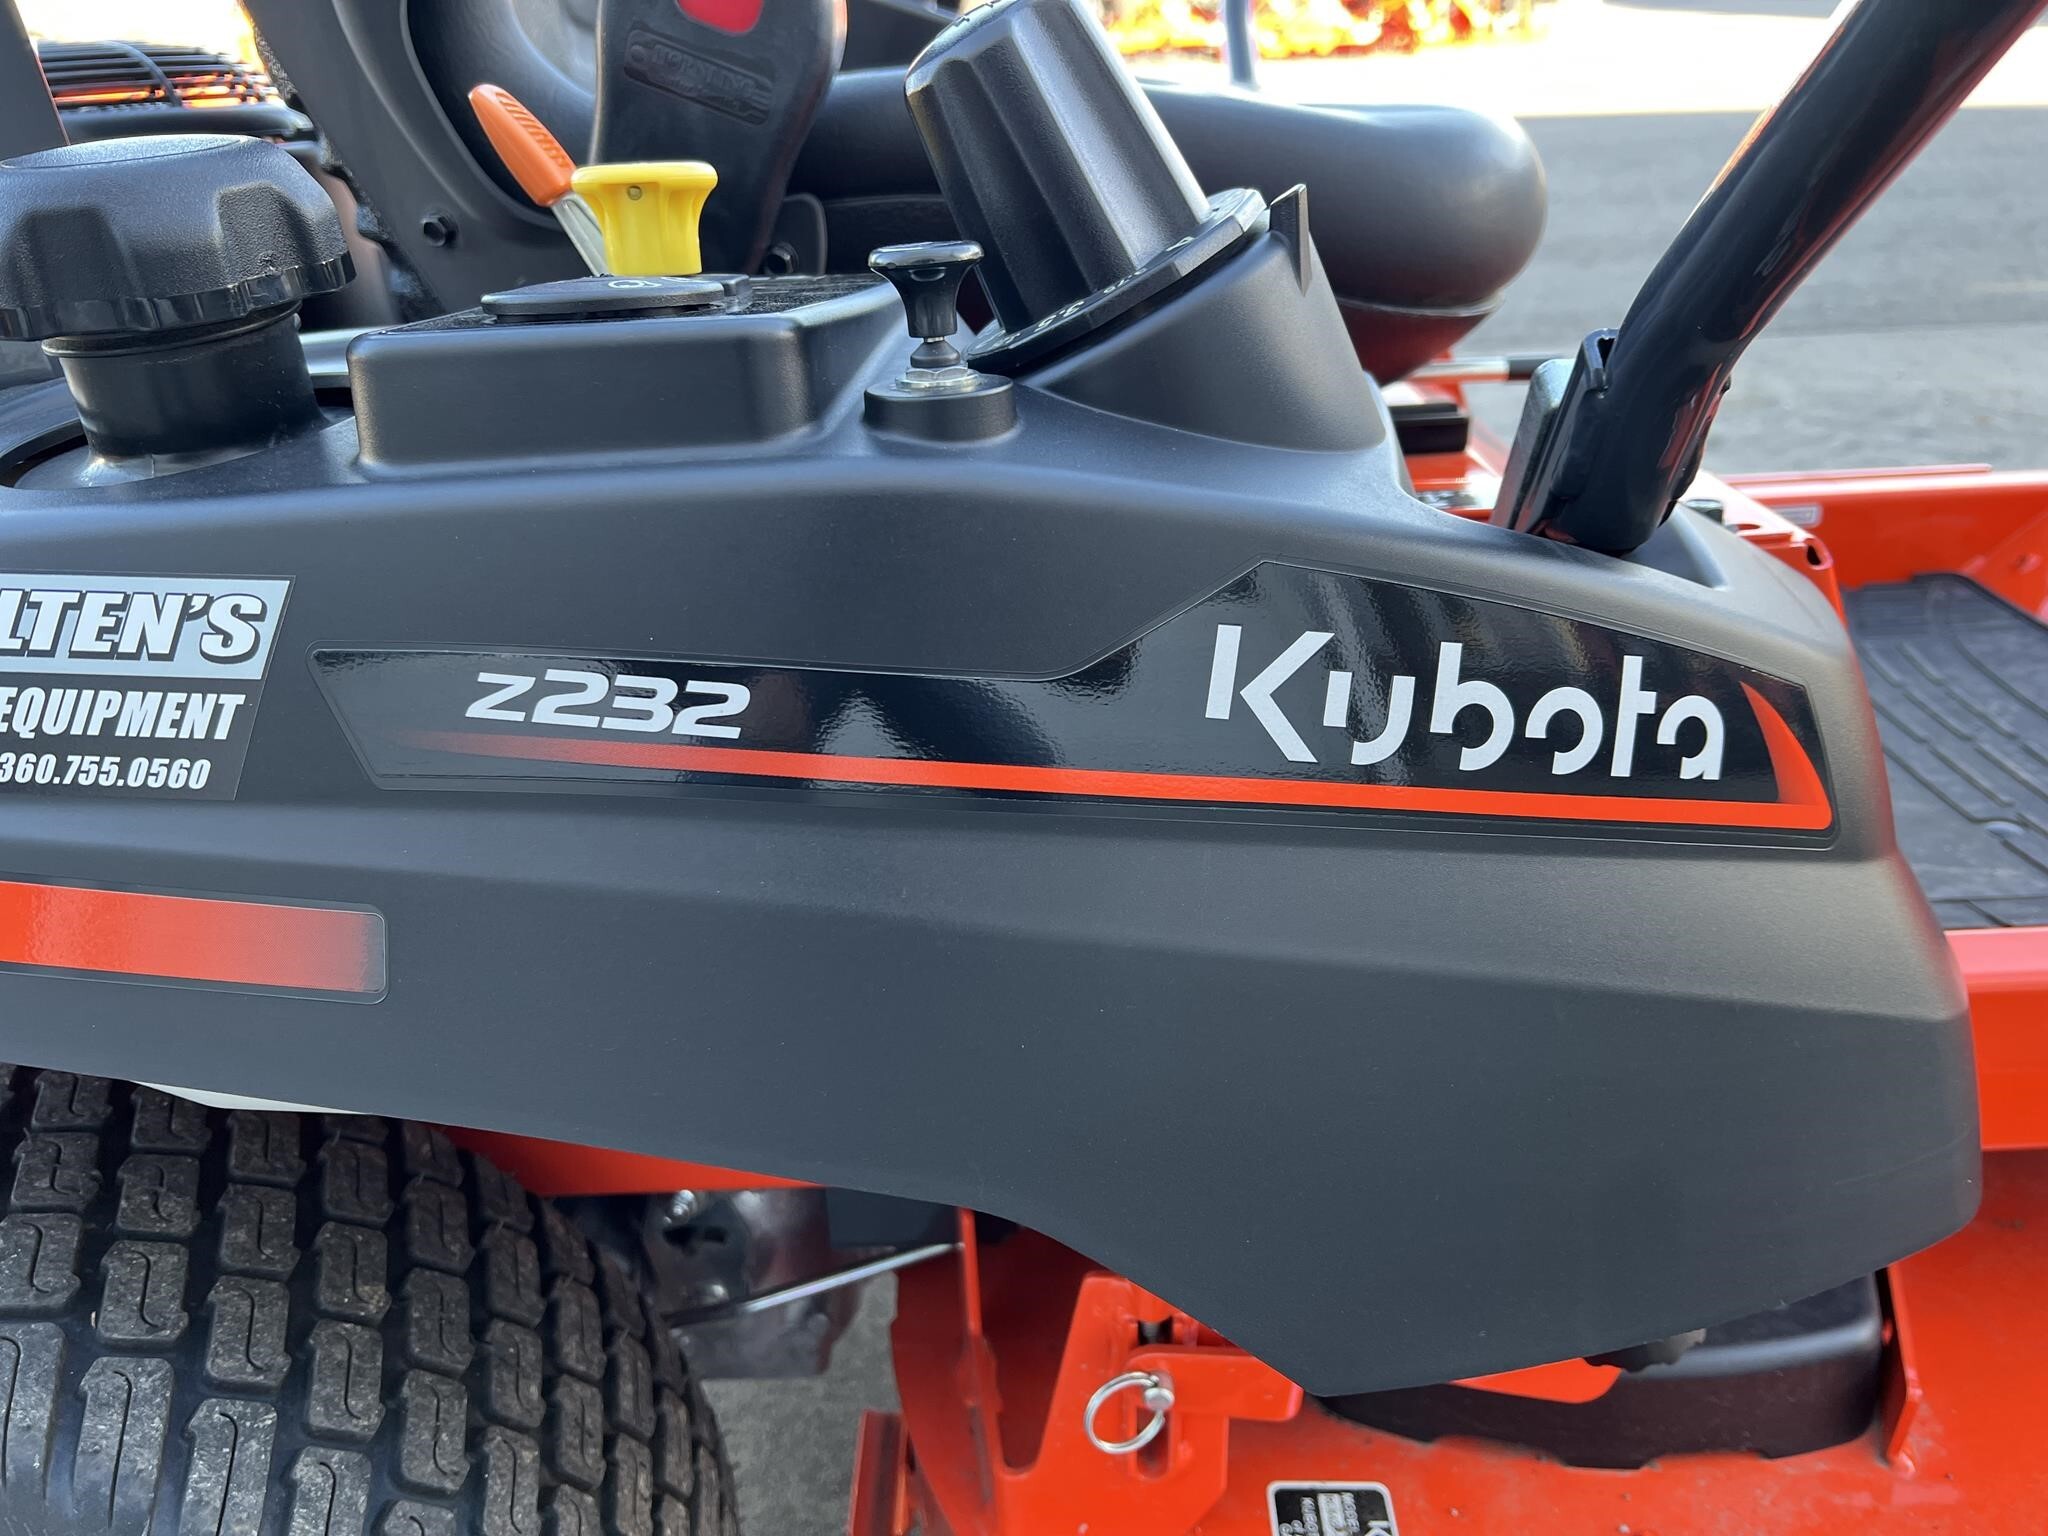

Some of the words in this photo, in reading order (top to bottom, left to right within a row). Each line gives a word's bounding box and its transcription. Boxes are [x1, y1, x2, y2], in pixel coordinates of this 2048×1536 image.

[0, 686, 246, 739] EQUIPMENT
[465, 669, 750, 739] Z232
[1205, 624, 1724, 780] Kubota
[0, 752, 211, 789] 360.755.0560
